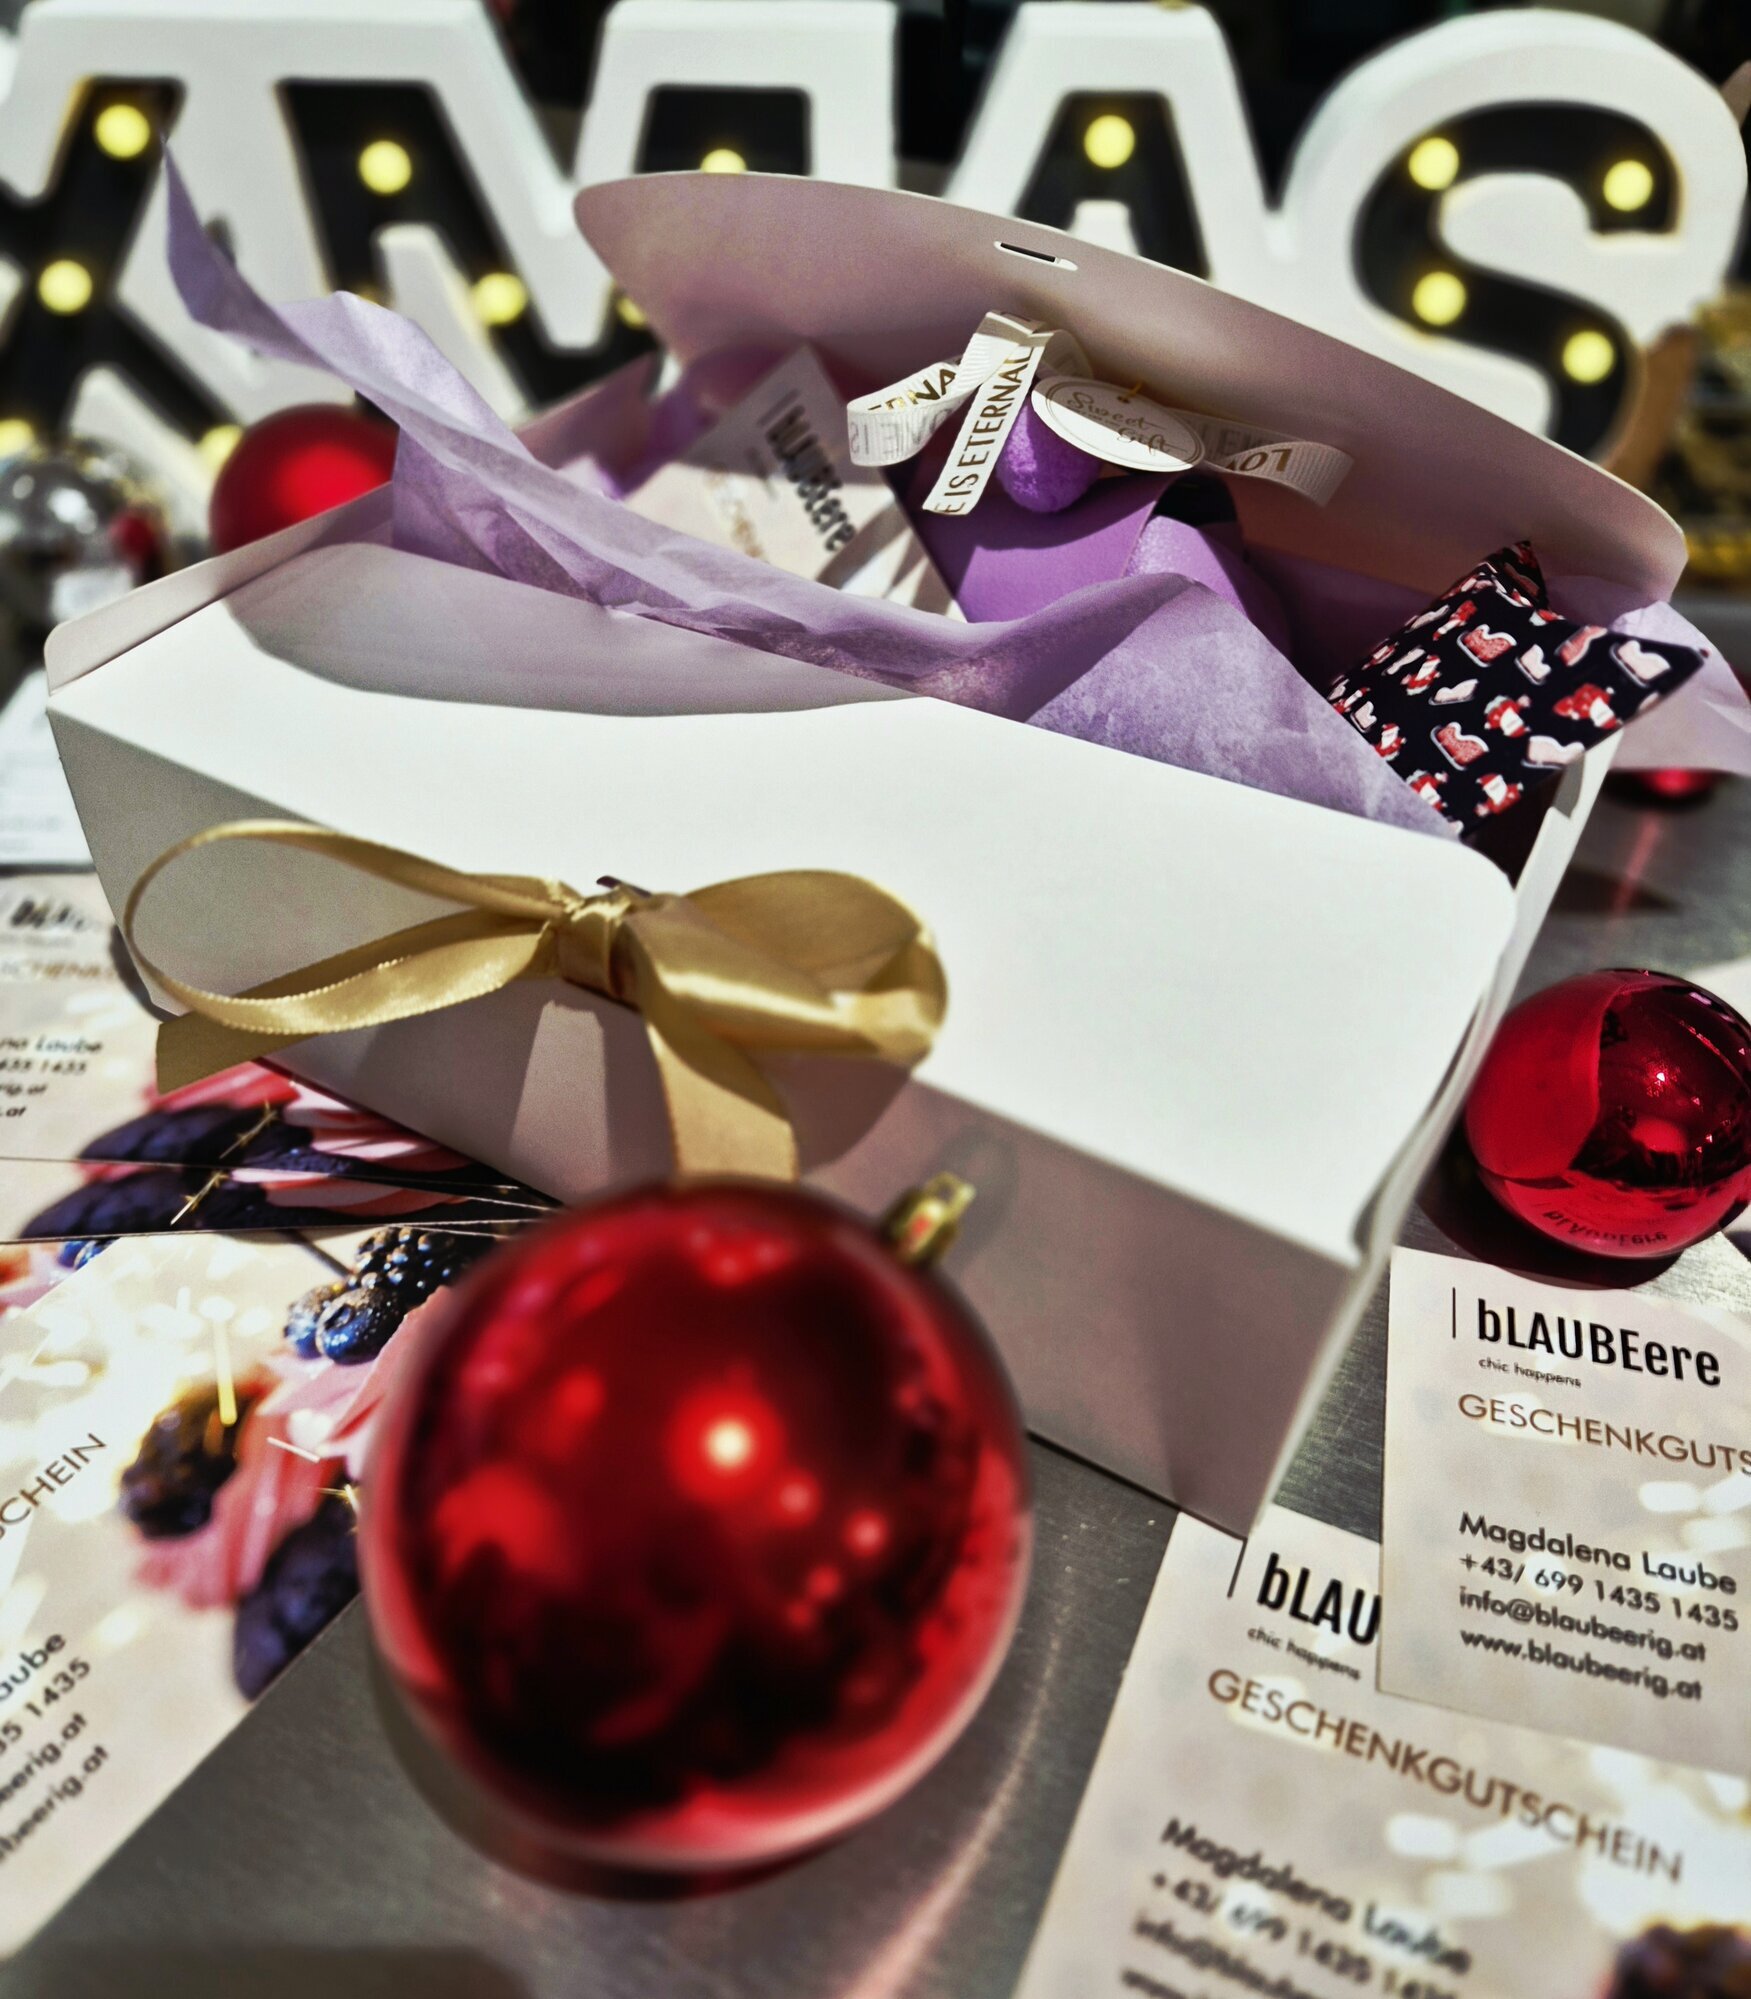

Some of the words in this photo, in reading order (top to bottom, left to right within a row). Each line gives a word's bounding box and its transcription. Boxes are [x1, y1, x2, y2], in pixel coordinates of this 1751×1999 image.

[956, 347, 1035, 468] ETERNAL
[1067, 391, 1166, 430] Sweet
[1117, 427, 1188, 456] Gift
[1476, 1297, 1722, 1387] bLAUBEere
[1478, 1356, 1510, 1375] chic
[1513, 1361, 1582, 1389] happens
[1458, 1510, 1632, 1573] Magdalena
[1642, 1550, 1738, 1595] Laube
[1256, 1551, 1383, 1647] bLAU
[1458, 1585, 1707, 1663] info@blaubeerig.at
[1459, 1553, 1526, 1585] +43/
[1533, 1568, 1584, 1597] 699
[1593, 1578, 1661, 1615] 1435
[1672, 1596, 1740, 1632] 1435
[24, 1657, 91, 1718] 1435
[1246, 1625, 1282, 1650] chic
[1285, 1637, 1362, 1682] happens
[1459, 1628, 1703, 1701] www.blaubeerig.at
[1207, 1668, 1684, 1886] GESCHENKGUTSCHEIN
[1161, 1815, 1353, 1924] Magdalena
